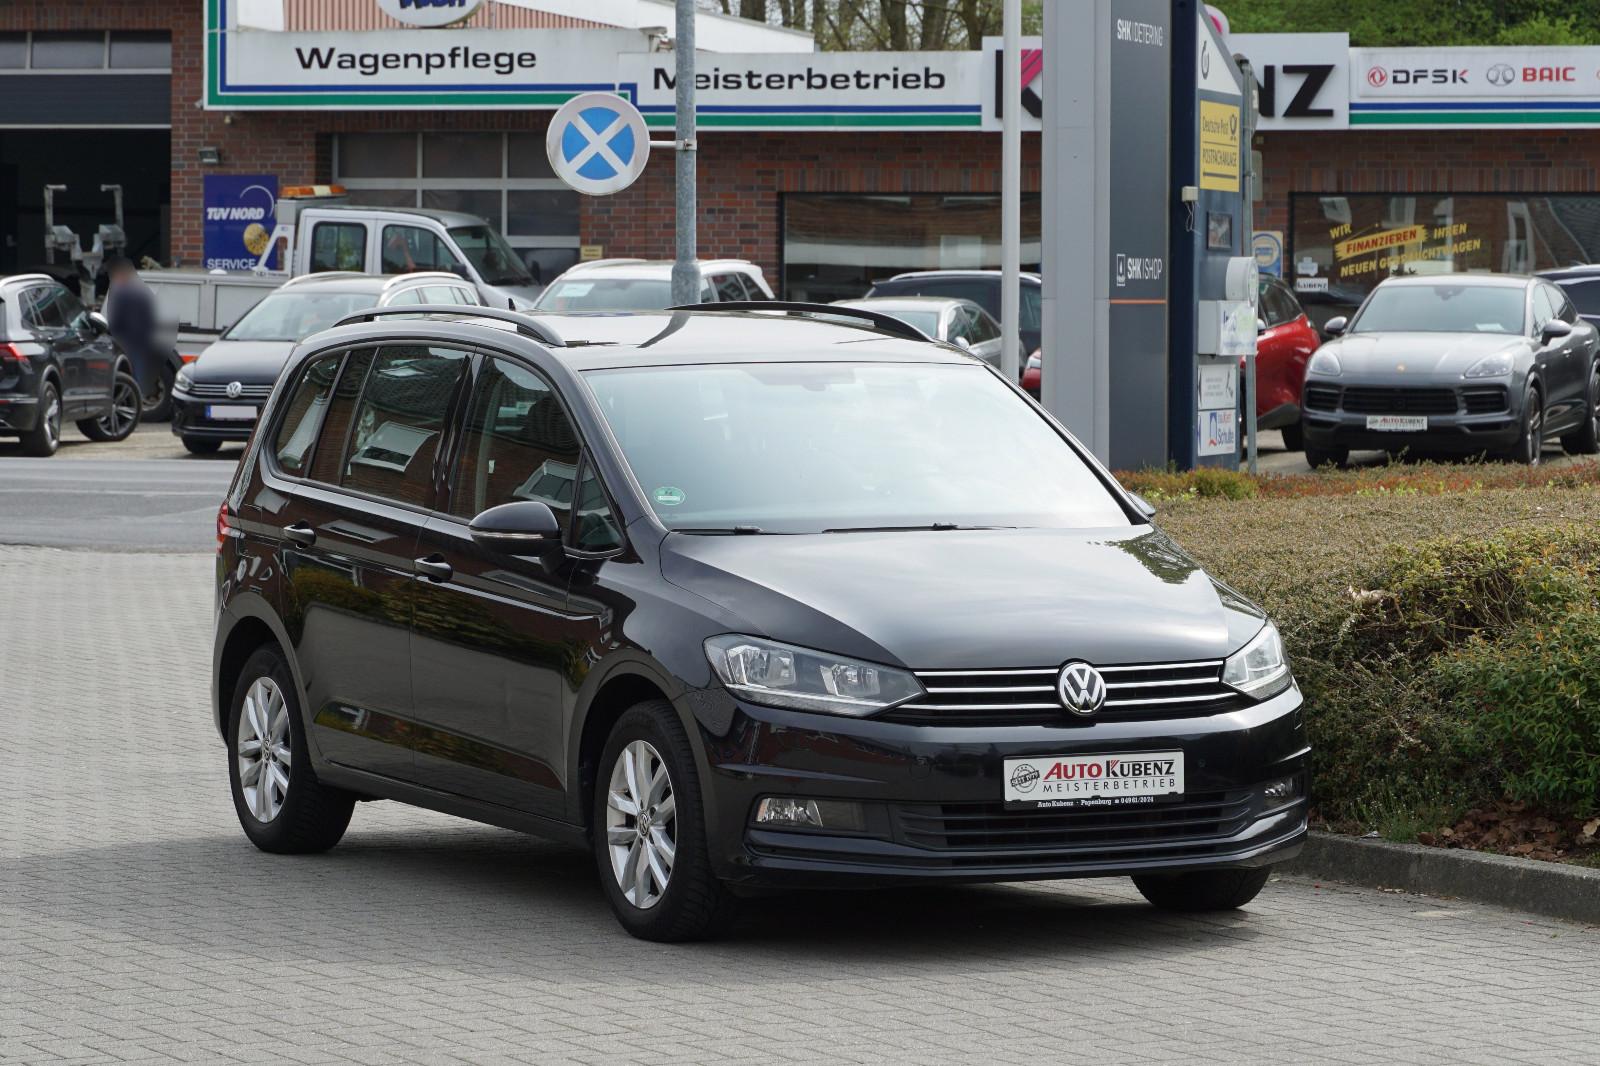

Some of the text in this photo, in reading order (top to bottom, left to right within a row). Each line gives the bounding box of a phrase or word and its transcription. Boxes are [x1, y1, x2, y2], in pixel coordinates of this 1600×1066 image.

[1117, 18, 1131, 41] SHK
[296, 47, 537, 76] Wagenpflege
[654, 67, 946, 90] Meisterbetrieb
[1393, 69, 1470, 84] DFSK
[1522, 67, 1576, 82] BAIC
[229, 207, 265, 220] NORD
[1330, 223, 1352, 240] WIR
[1434, 223, 1467, 239] IHREN
[1346, 229, 1417, 254] FINANZIEREN
[207, 258, 256, 270] SERVICE
[1127, 257, 1163, 280] SHK SHOP
[1340, 260, 1377, 278] NEUEN
[1043, 762, 1102, 780] AUTO
[1106, 759, 1175, 779] KUBENZ
[1043, 779, 1176, 793] MEISTERBETRIEB
